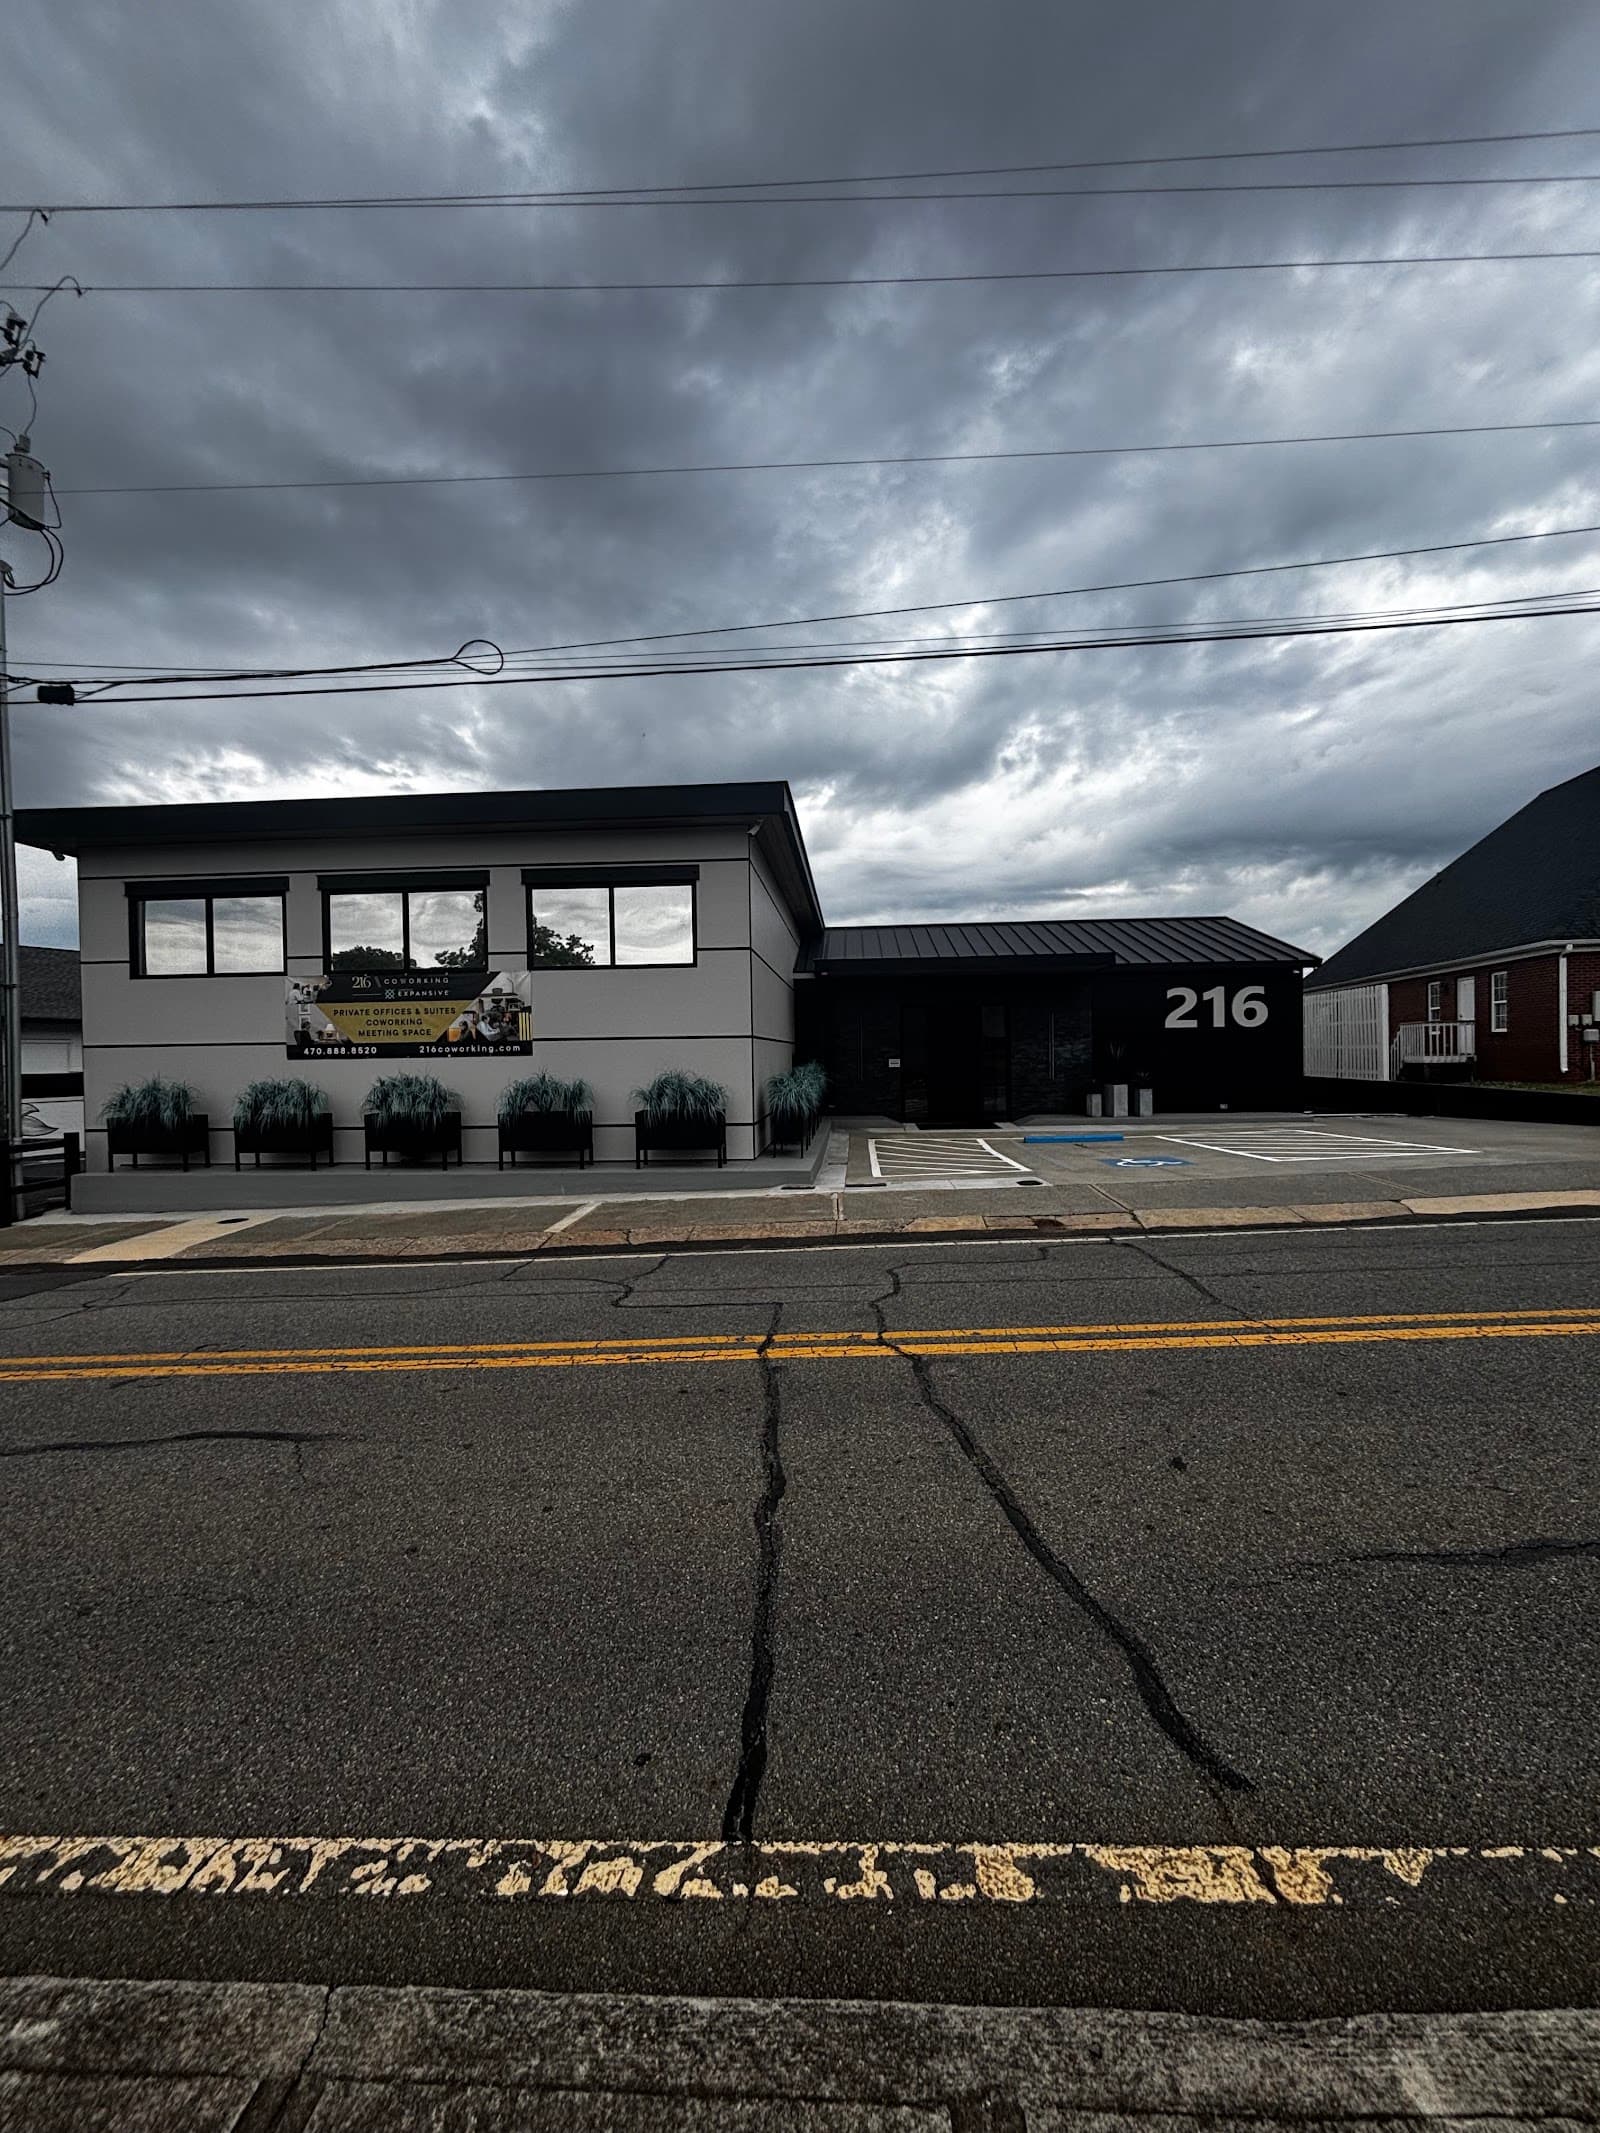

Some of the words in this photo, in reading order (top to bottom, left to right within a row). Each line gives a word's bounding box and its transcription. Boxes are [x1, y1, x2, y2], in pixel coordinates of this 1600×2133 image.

[352, 976, 372, 989] 216
[384, 977, 449, 985] COWORKING
[397, 989, 449, 997] EXPANSIVE
[1165, 985, 1269, 1028] 216
[333, 1008, 370, 1016] PRIVATE
[373, 1007, 412, 1016] OFFICES
[424, 1007, 456, 1015] SUITES
[366, 1018, 423, 1027] COWORKING
[358, 1028, 399, 1037] MEETING
[402, 1028, 432, 1036] SPACE
[419, 1045, 521, 1054] 216coworking.com
